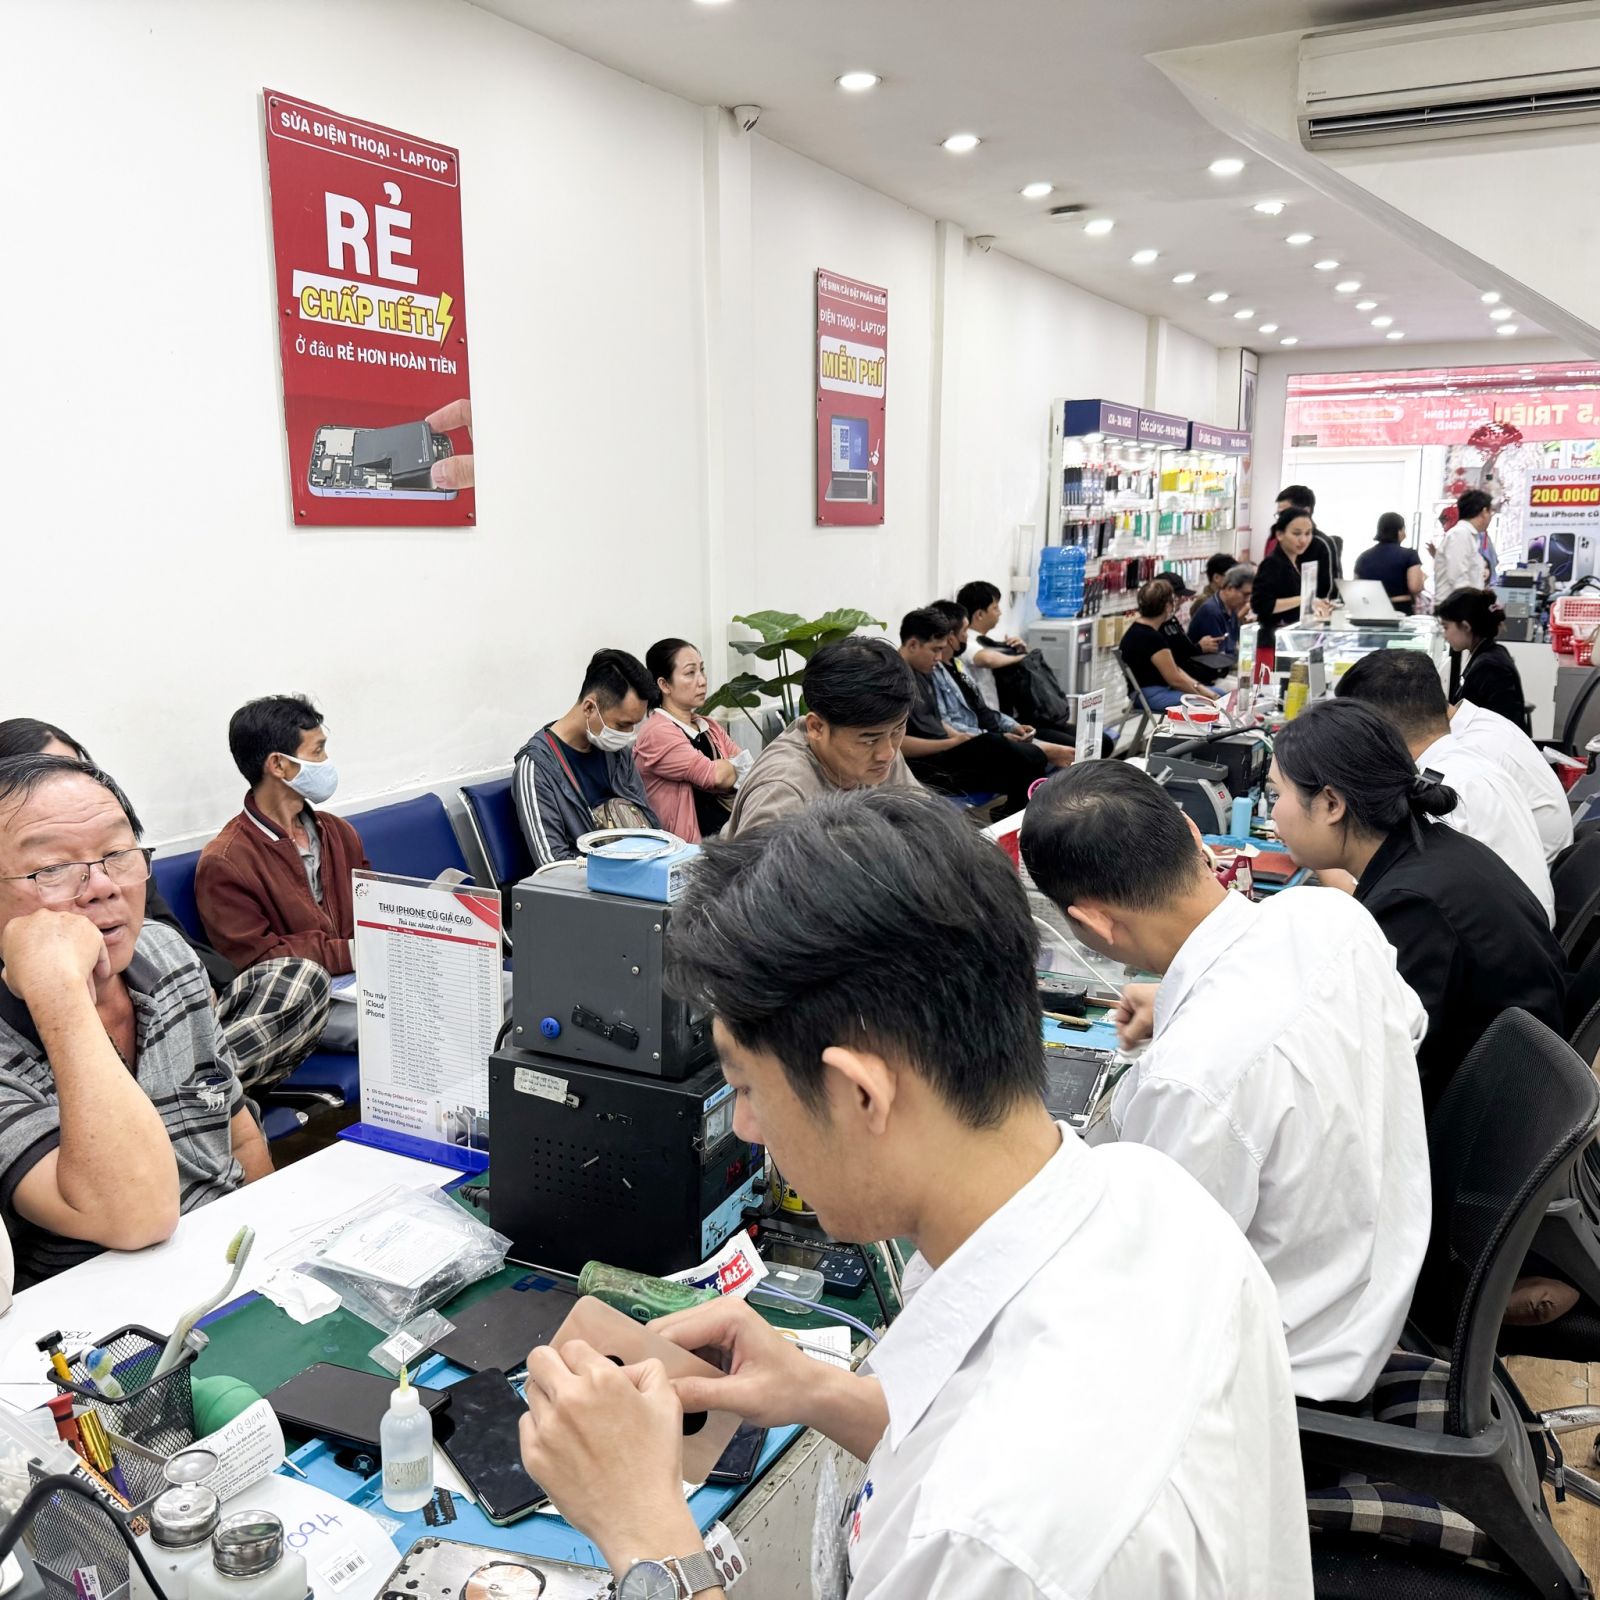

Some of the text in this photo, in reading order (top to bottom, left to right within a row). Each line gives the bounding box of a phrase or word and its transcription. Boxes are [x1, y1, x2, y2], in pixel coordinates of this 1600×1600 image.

[281, 111, 310, 134] SỬA
[313, 124, 347, 146] ĐIỆN
[349, 132, 390, 160] THOẠI
[400, 148, 449, 174] LAPTOP
[324, 181, 419, 286] RẺ
[300, 284, 435, 337] CHẤP HẾT!
[820, 308, 836, 326] ĐIỆN
[837, 313, 856, 332] THOẠI
[860, 321, 886, 337] LAPTOP
[295, 333, 457, 375] Ở đâu RẺ HƠN HOÀN TIỀN
[822, 344, 885, 387] MIỄN PHÍ
[1532, 487, 1600, 503] 200.000đ
[1551, 510, 1586, 518] iPhone
[378, 902, 473, 926] THU IPHONE CŨ GIÁ CAO
[417, 921, 436, 931] nhanh
[363, 989, 387, 1001] Thu máy
[366, 1000, 385, 1009] iCloud
[365, 1009, 385, 1019] iPhone
[283, 1512, 343, 1549] 094
